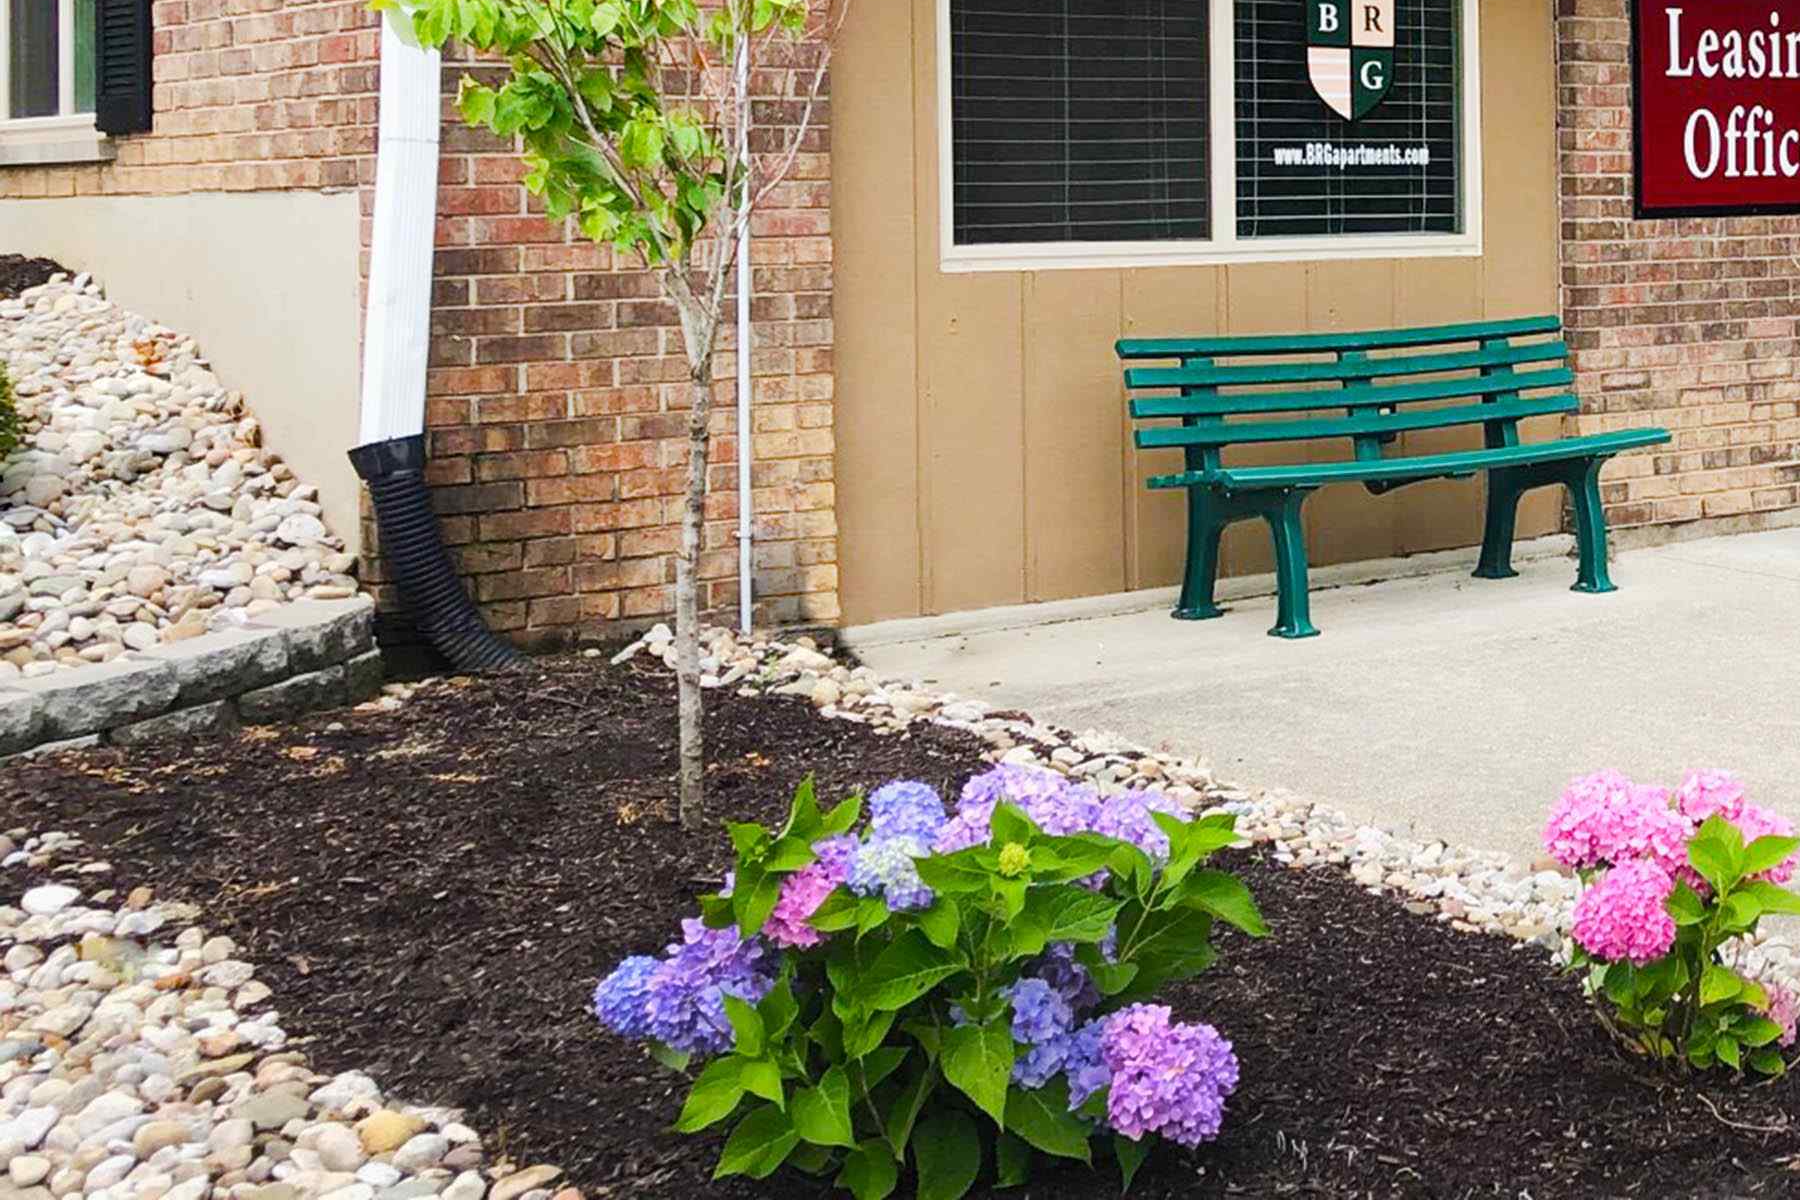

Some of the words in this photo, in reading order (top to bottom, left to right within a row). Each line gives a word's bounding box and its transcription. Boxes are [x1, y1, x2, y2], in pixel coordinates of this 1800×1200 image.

[1318, 3, 1339, 32] B
[1363, 5, 1384, 33] R
[1360, 60, 1384, 90] G
[1274, 142, 1430, 171] www.BRGapartments.com
